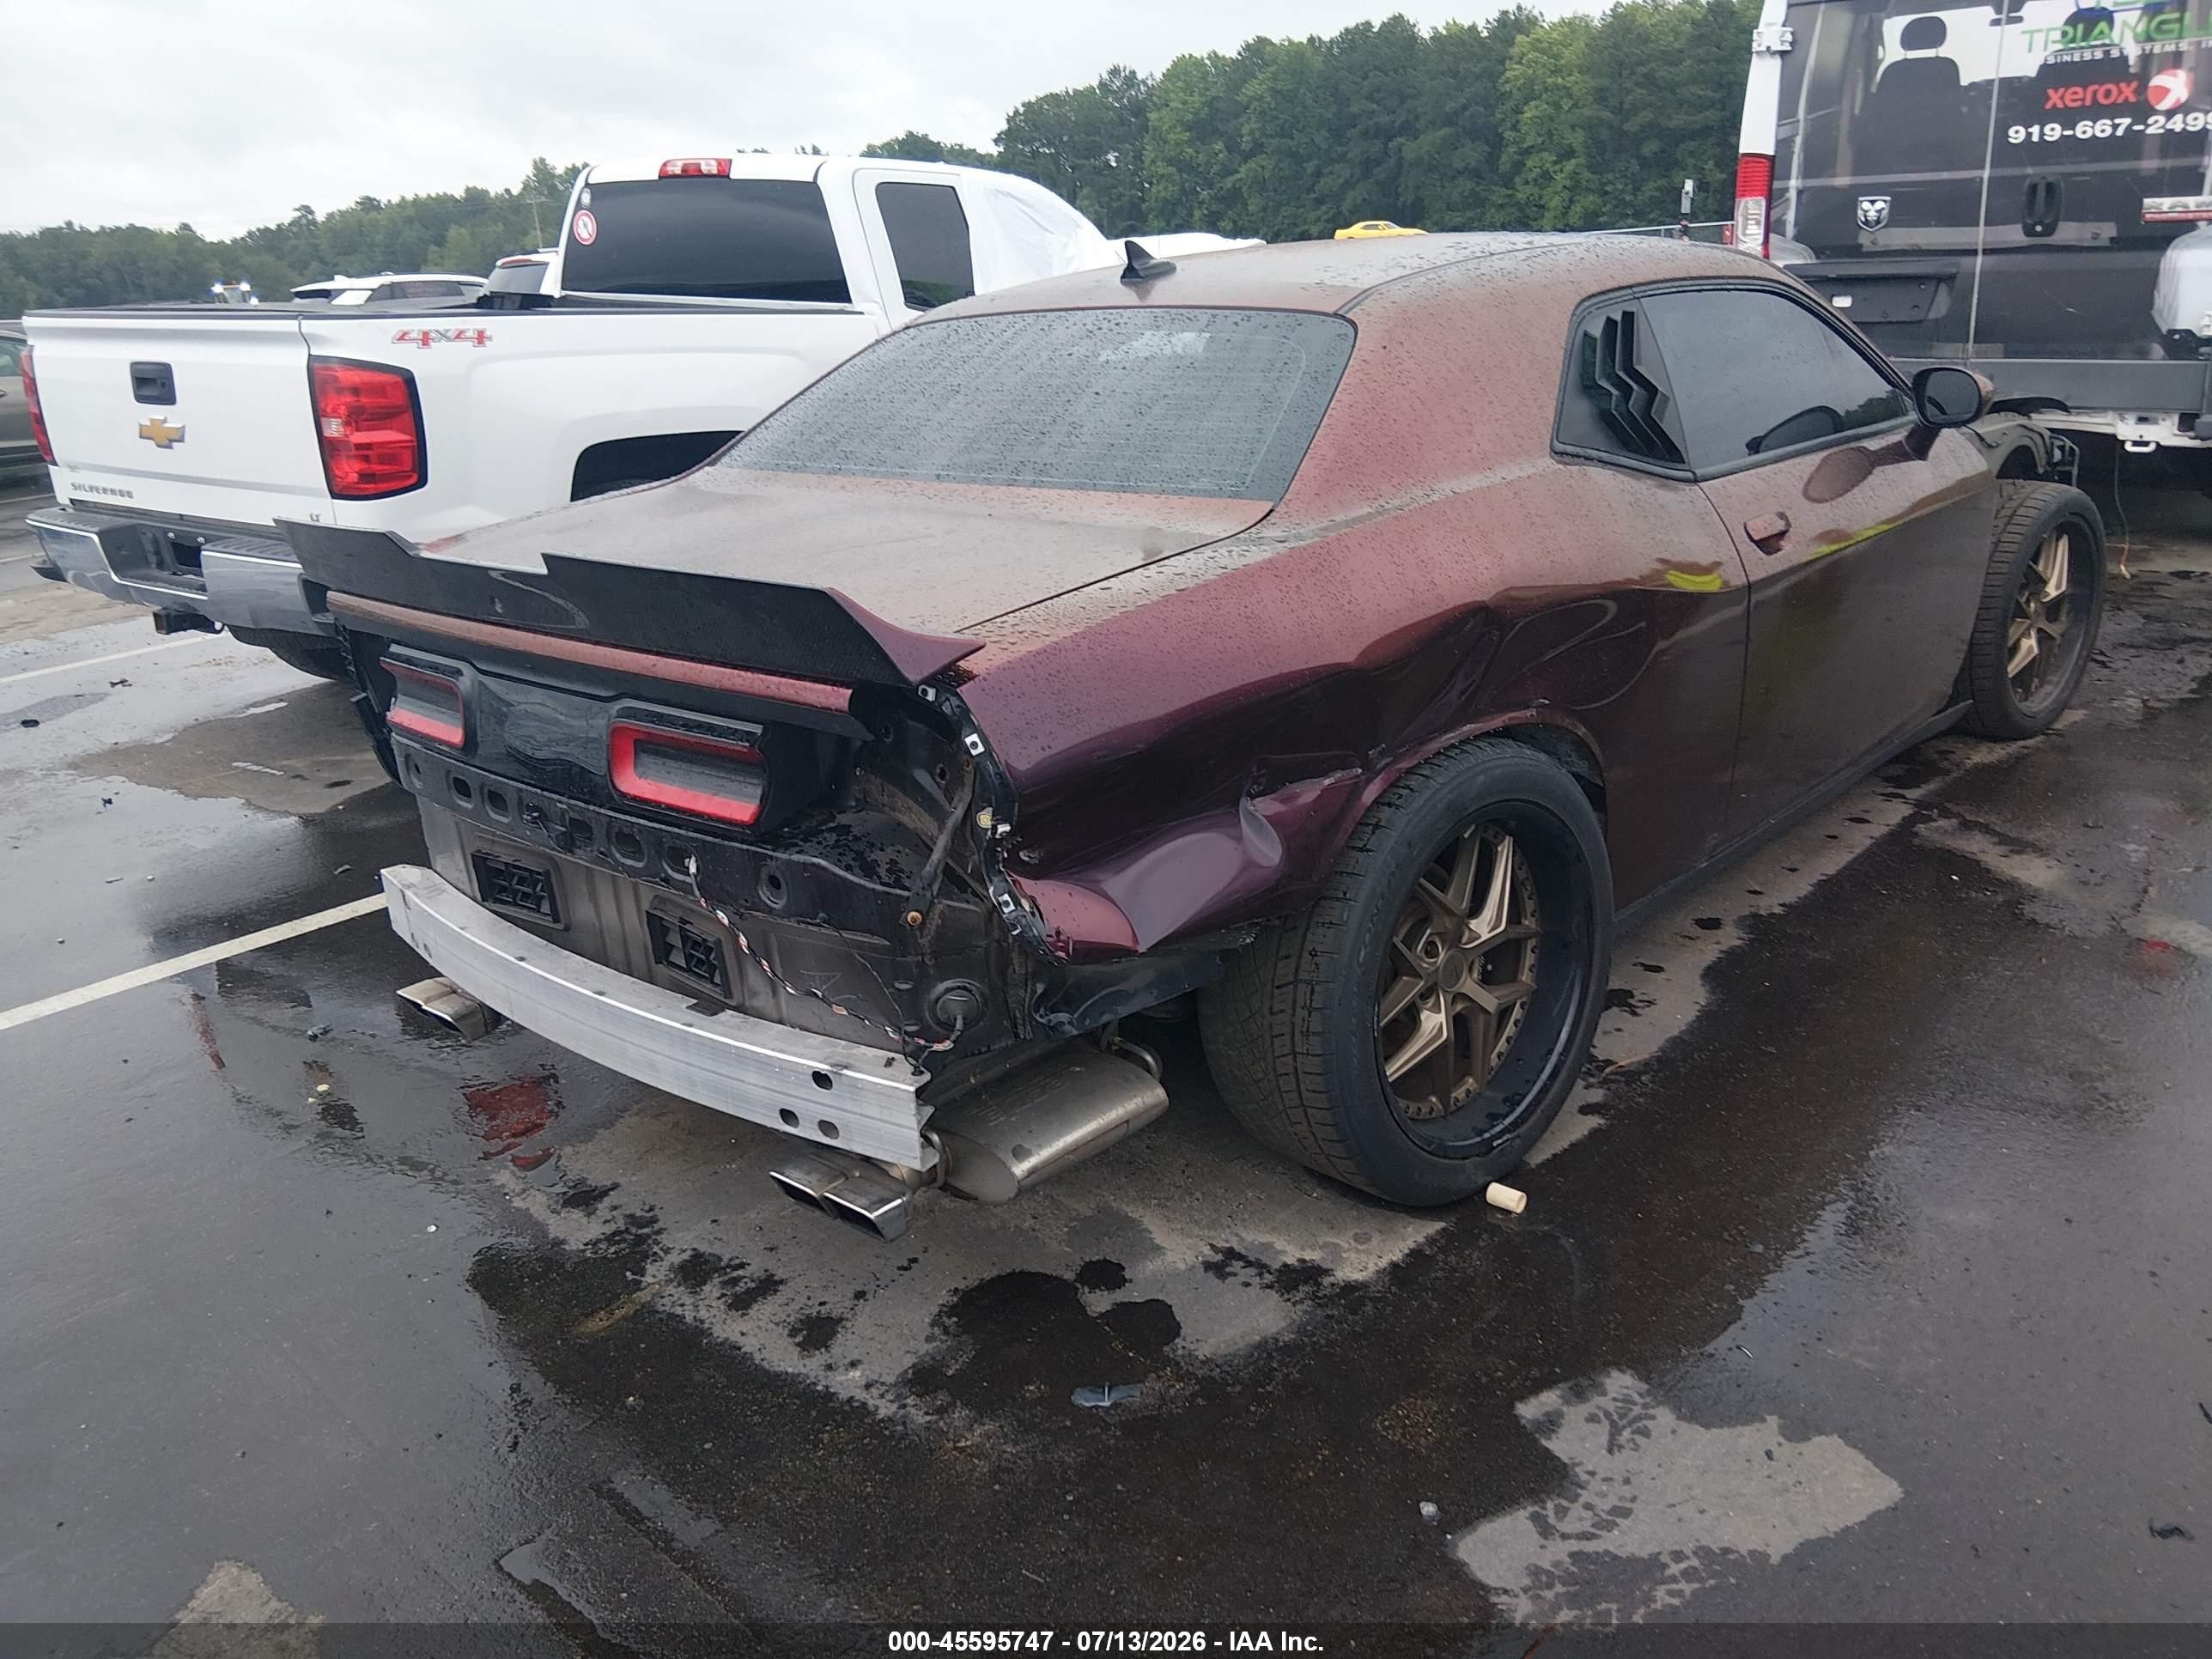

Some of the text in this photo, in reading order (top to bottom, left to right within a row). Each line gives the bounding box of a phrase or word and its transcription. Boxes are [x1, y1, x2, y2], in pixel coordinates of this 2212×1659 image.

[2021, 11, 2212, 53] TRIANGL
[2044, 80, 2139, 110] xerox
[70, 482, 134, 499] SILVERADO
